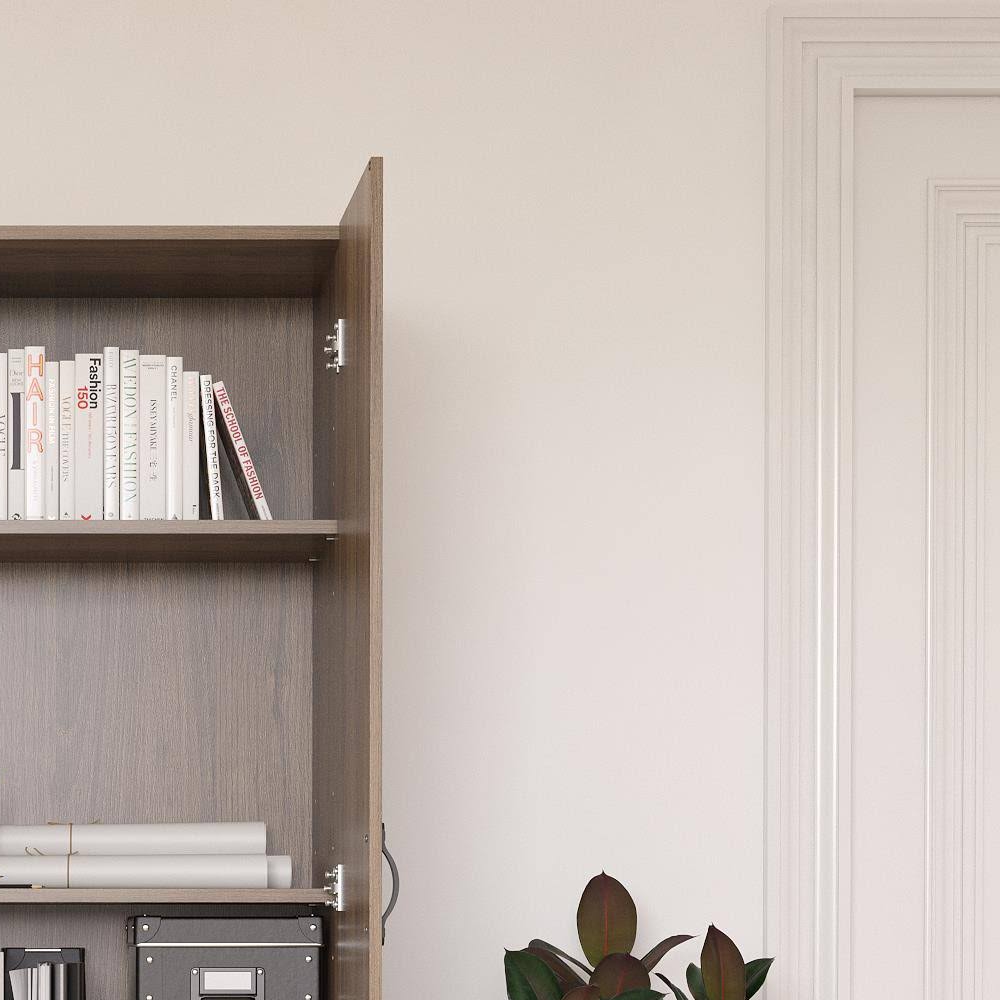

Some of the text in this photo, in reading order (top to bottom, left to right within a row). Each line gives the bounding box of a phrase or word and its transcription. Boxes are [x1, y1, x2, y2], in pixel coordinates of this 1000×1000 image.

[26, 353, 44, 453] HAIR
[62, 395, 72, 431] VOGUE
[78, 385, 88, 410] 150
[89, 358, 102, 409] Fashion
[122, 432, 137, 503] FASHION
[203, 380, 221, 498] DRESSING FOR THE DARK
[216, 386, 264, 500] THE SCHOOL OF FASHION
